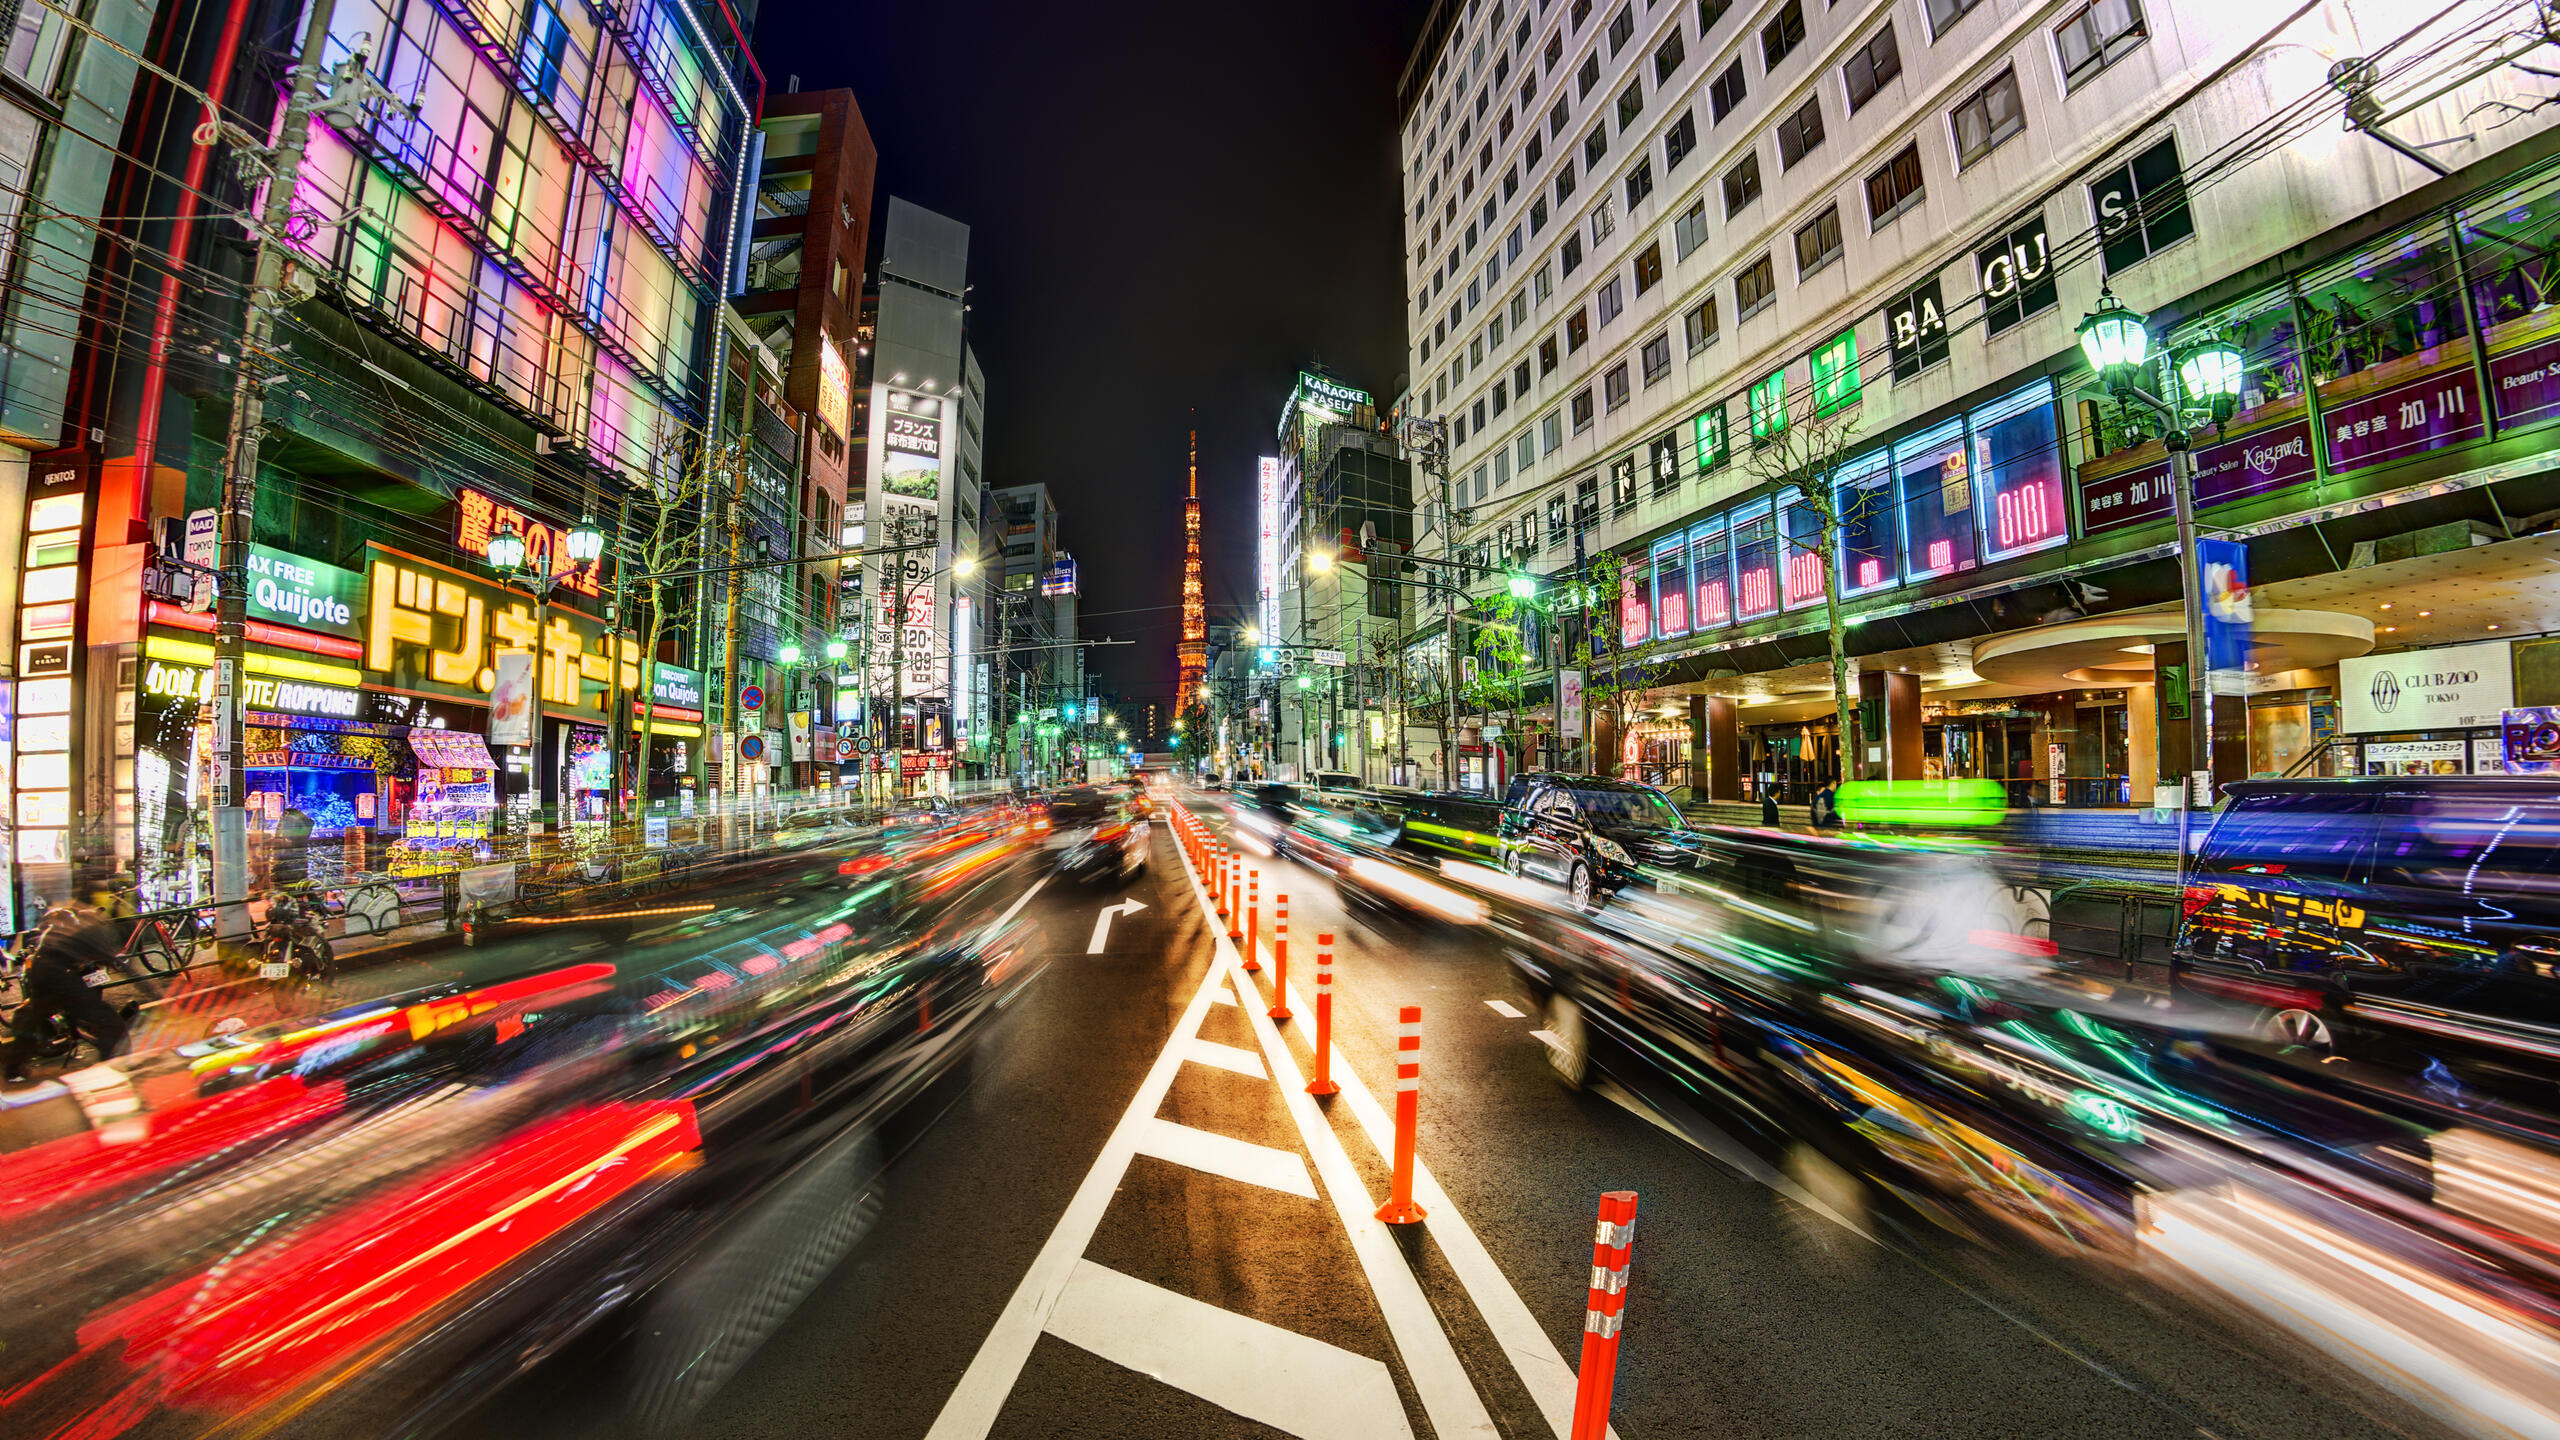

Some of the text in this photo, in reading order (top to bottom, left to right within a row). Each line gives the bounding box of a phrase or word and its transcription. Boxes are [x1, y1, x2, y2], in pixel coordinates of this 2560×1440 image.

[1304, 375, 1364, 403] KARAOKE
[2503, 367, 2547, 390] Beauty
[2336, 385, 2465, 444] 美容室 加川
[2219, 459, 2239, 473] Salon
[2243, 435, 2309, 475] Kagawa
[2090, 473, 2173, 513] 美容室 加川
[190, 518, 214, 533] MAID
[188, 540, 213, 553] TOKYO
[247, 553, 316, 587] AX FREE
[255, 579, 350, 625] Quijote
[660, 668, 689, 684] DISCOUNT
[2405, 673, 2445, 689] CLUB
[668, 682, 699, 706] Quijote
[2424, 693, 2460, 704] TOKYO
[860, 741, 870, 750] 40
